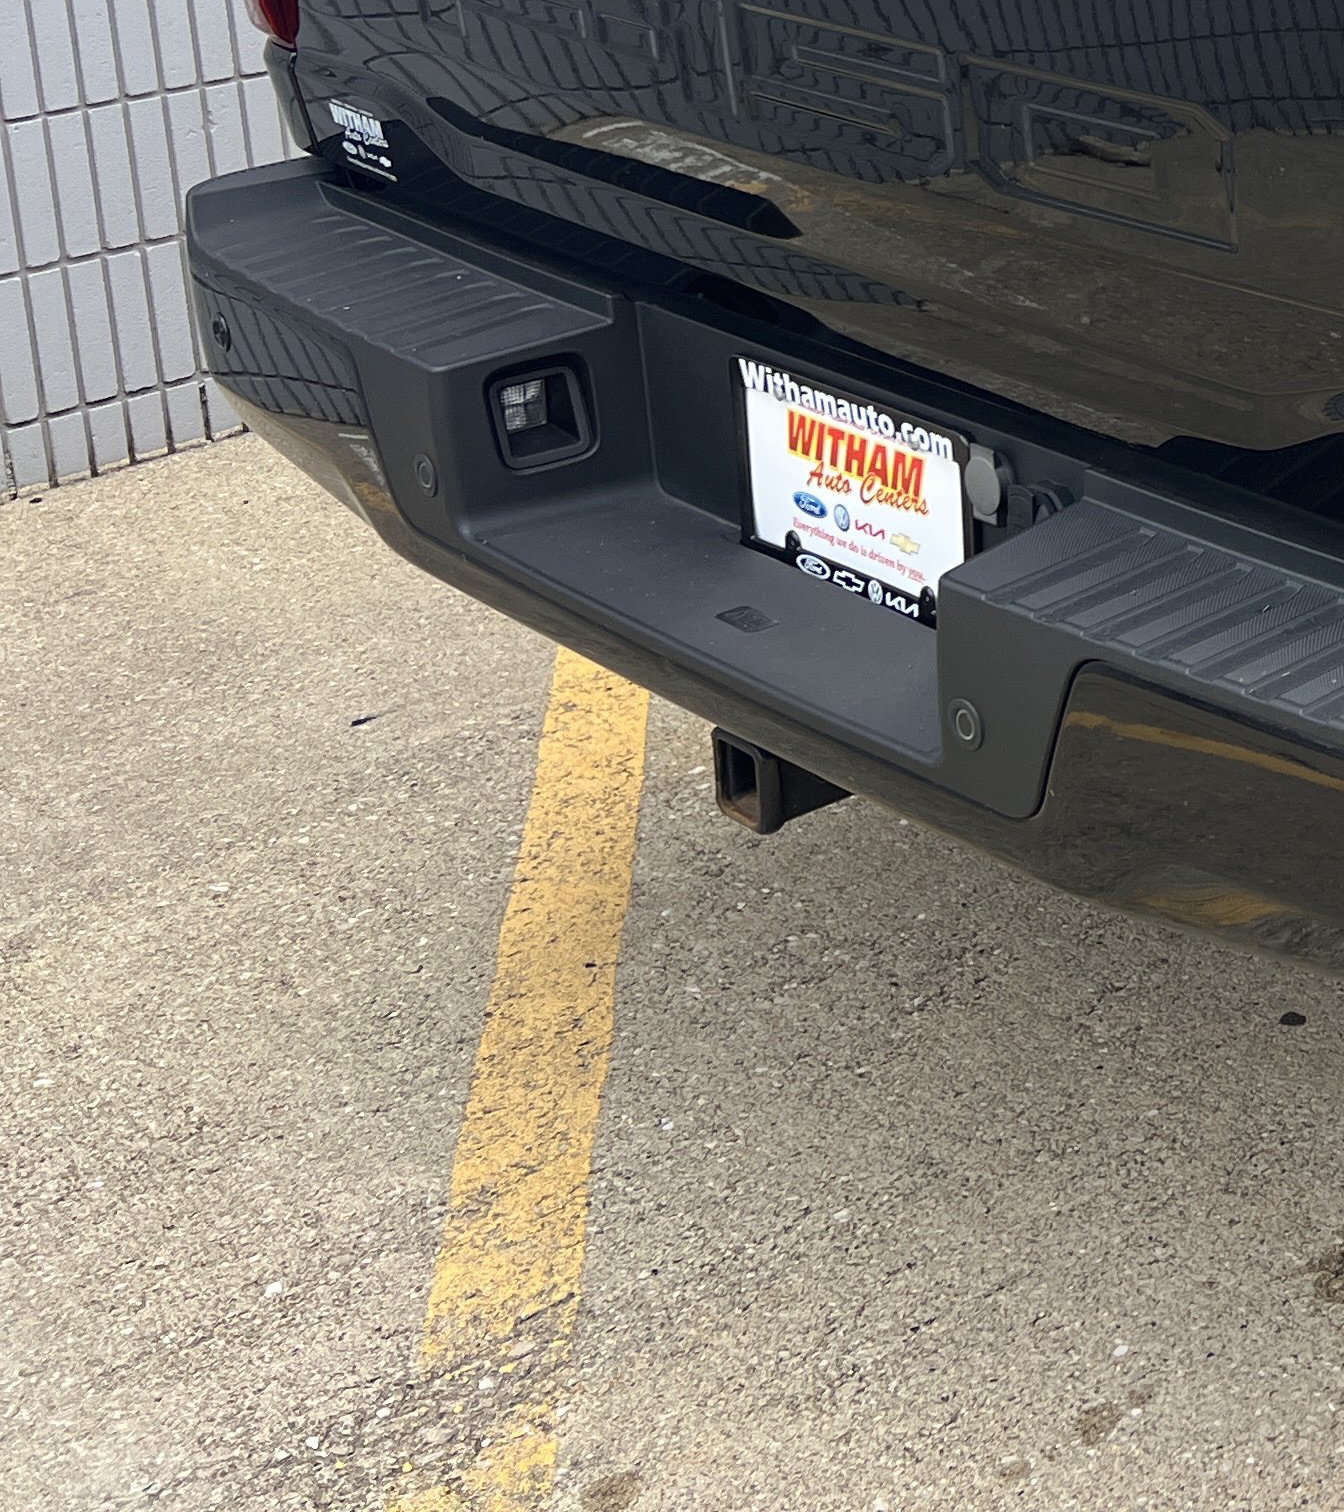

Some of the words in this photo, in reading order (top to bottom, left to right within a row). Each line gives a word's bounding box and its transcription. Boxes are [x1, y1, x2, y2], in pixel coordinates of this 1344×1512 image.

[738, 358, 954, 462] Withamauto.com
[786, 408, 925, 497] WITHAM
[806, 459, 852, 494] Auto
[859, 472, 929, 516] Centers
[793, 516, 835, 547] Everything
